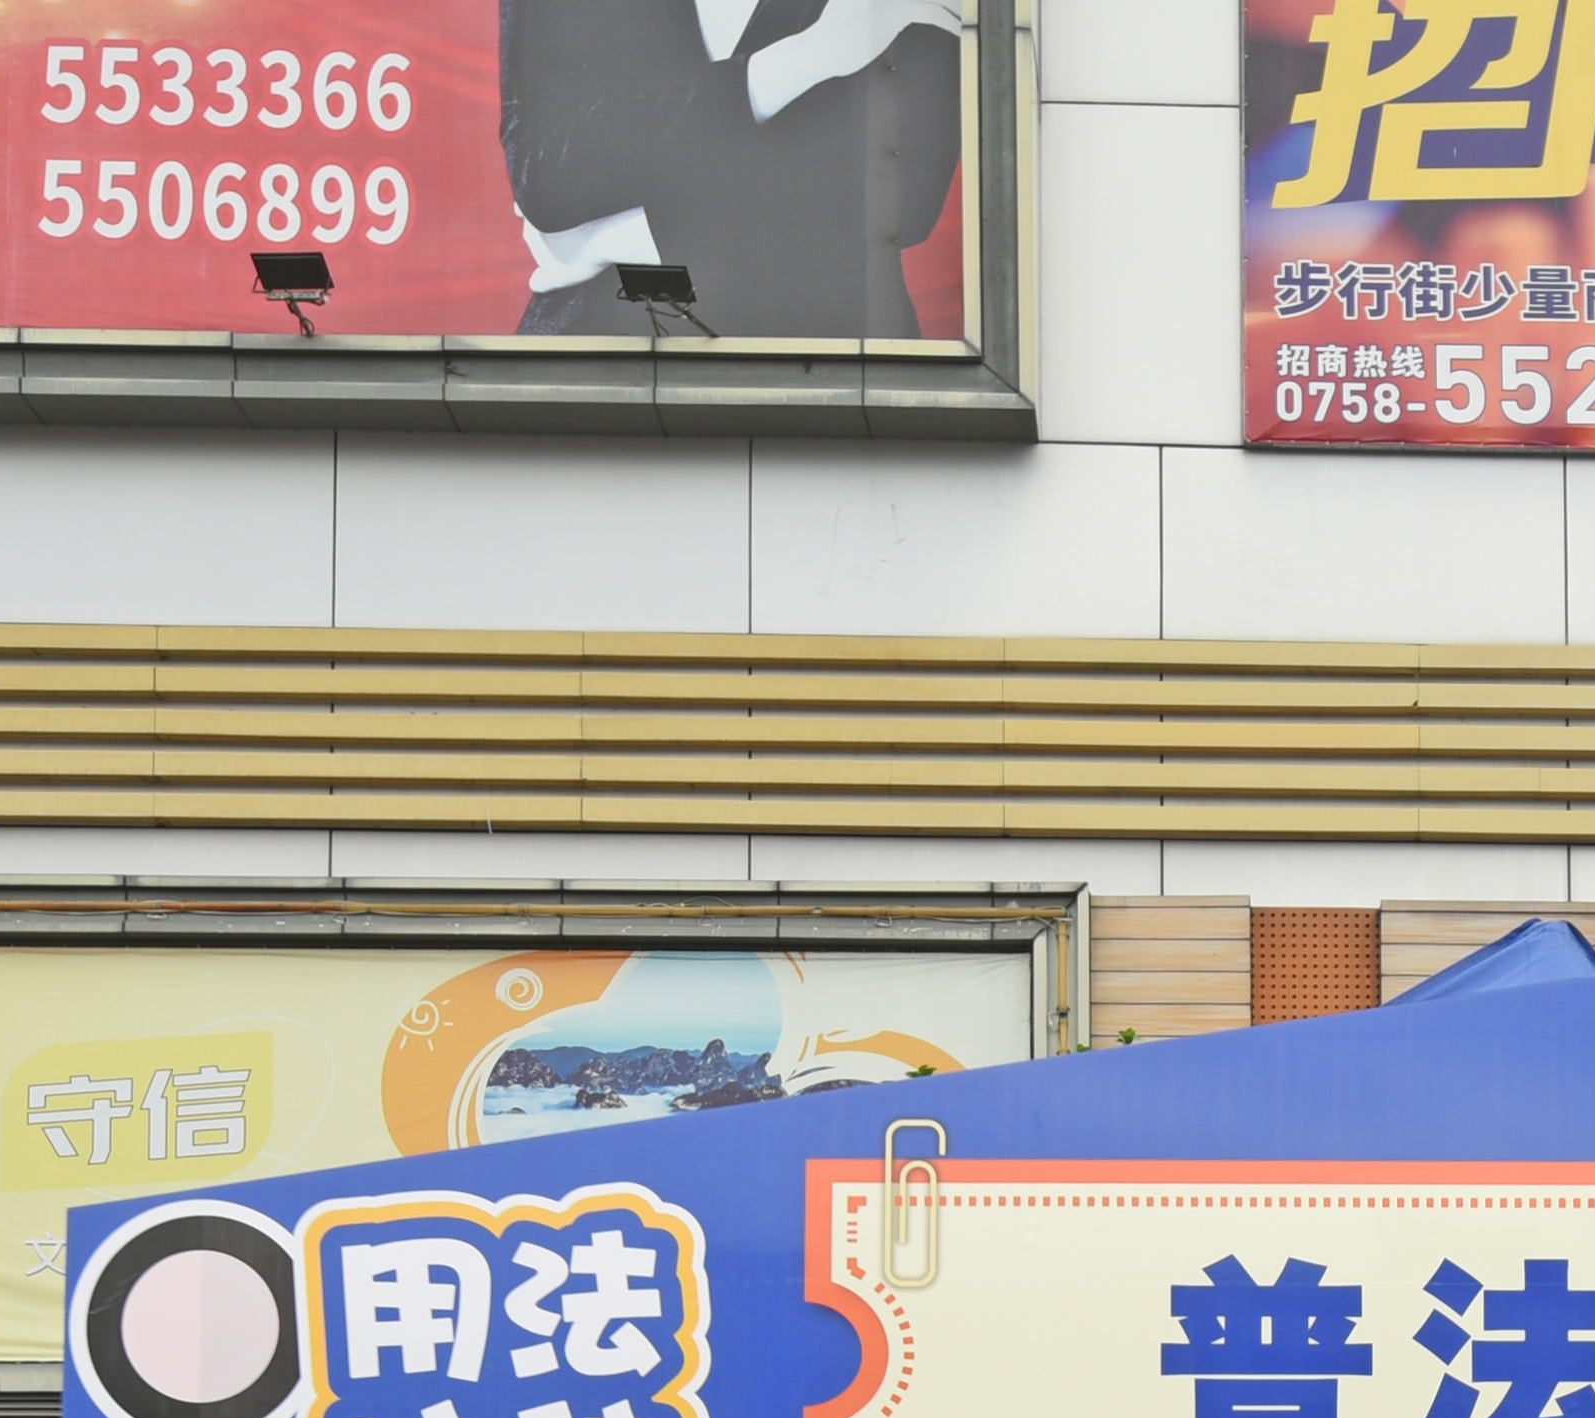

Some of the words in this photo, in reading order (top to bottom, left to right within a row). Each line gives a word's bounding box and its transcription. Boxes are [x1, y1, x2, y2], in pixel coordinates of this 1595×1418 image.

[1275, 343, 1427, 380] 招商热线
[26, 1065, 253, 1166] 守信
[341, 1229, 663, 1383] 用法
